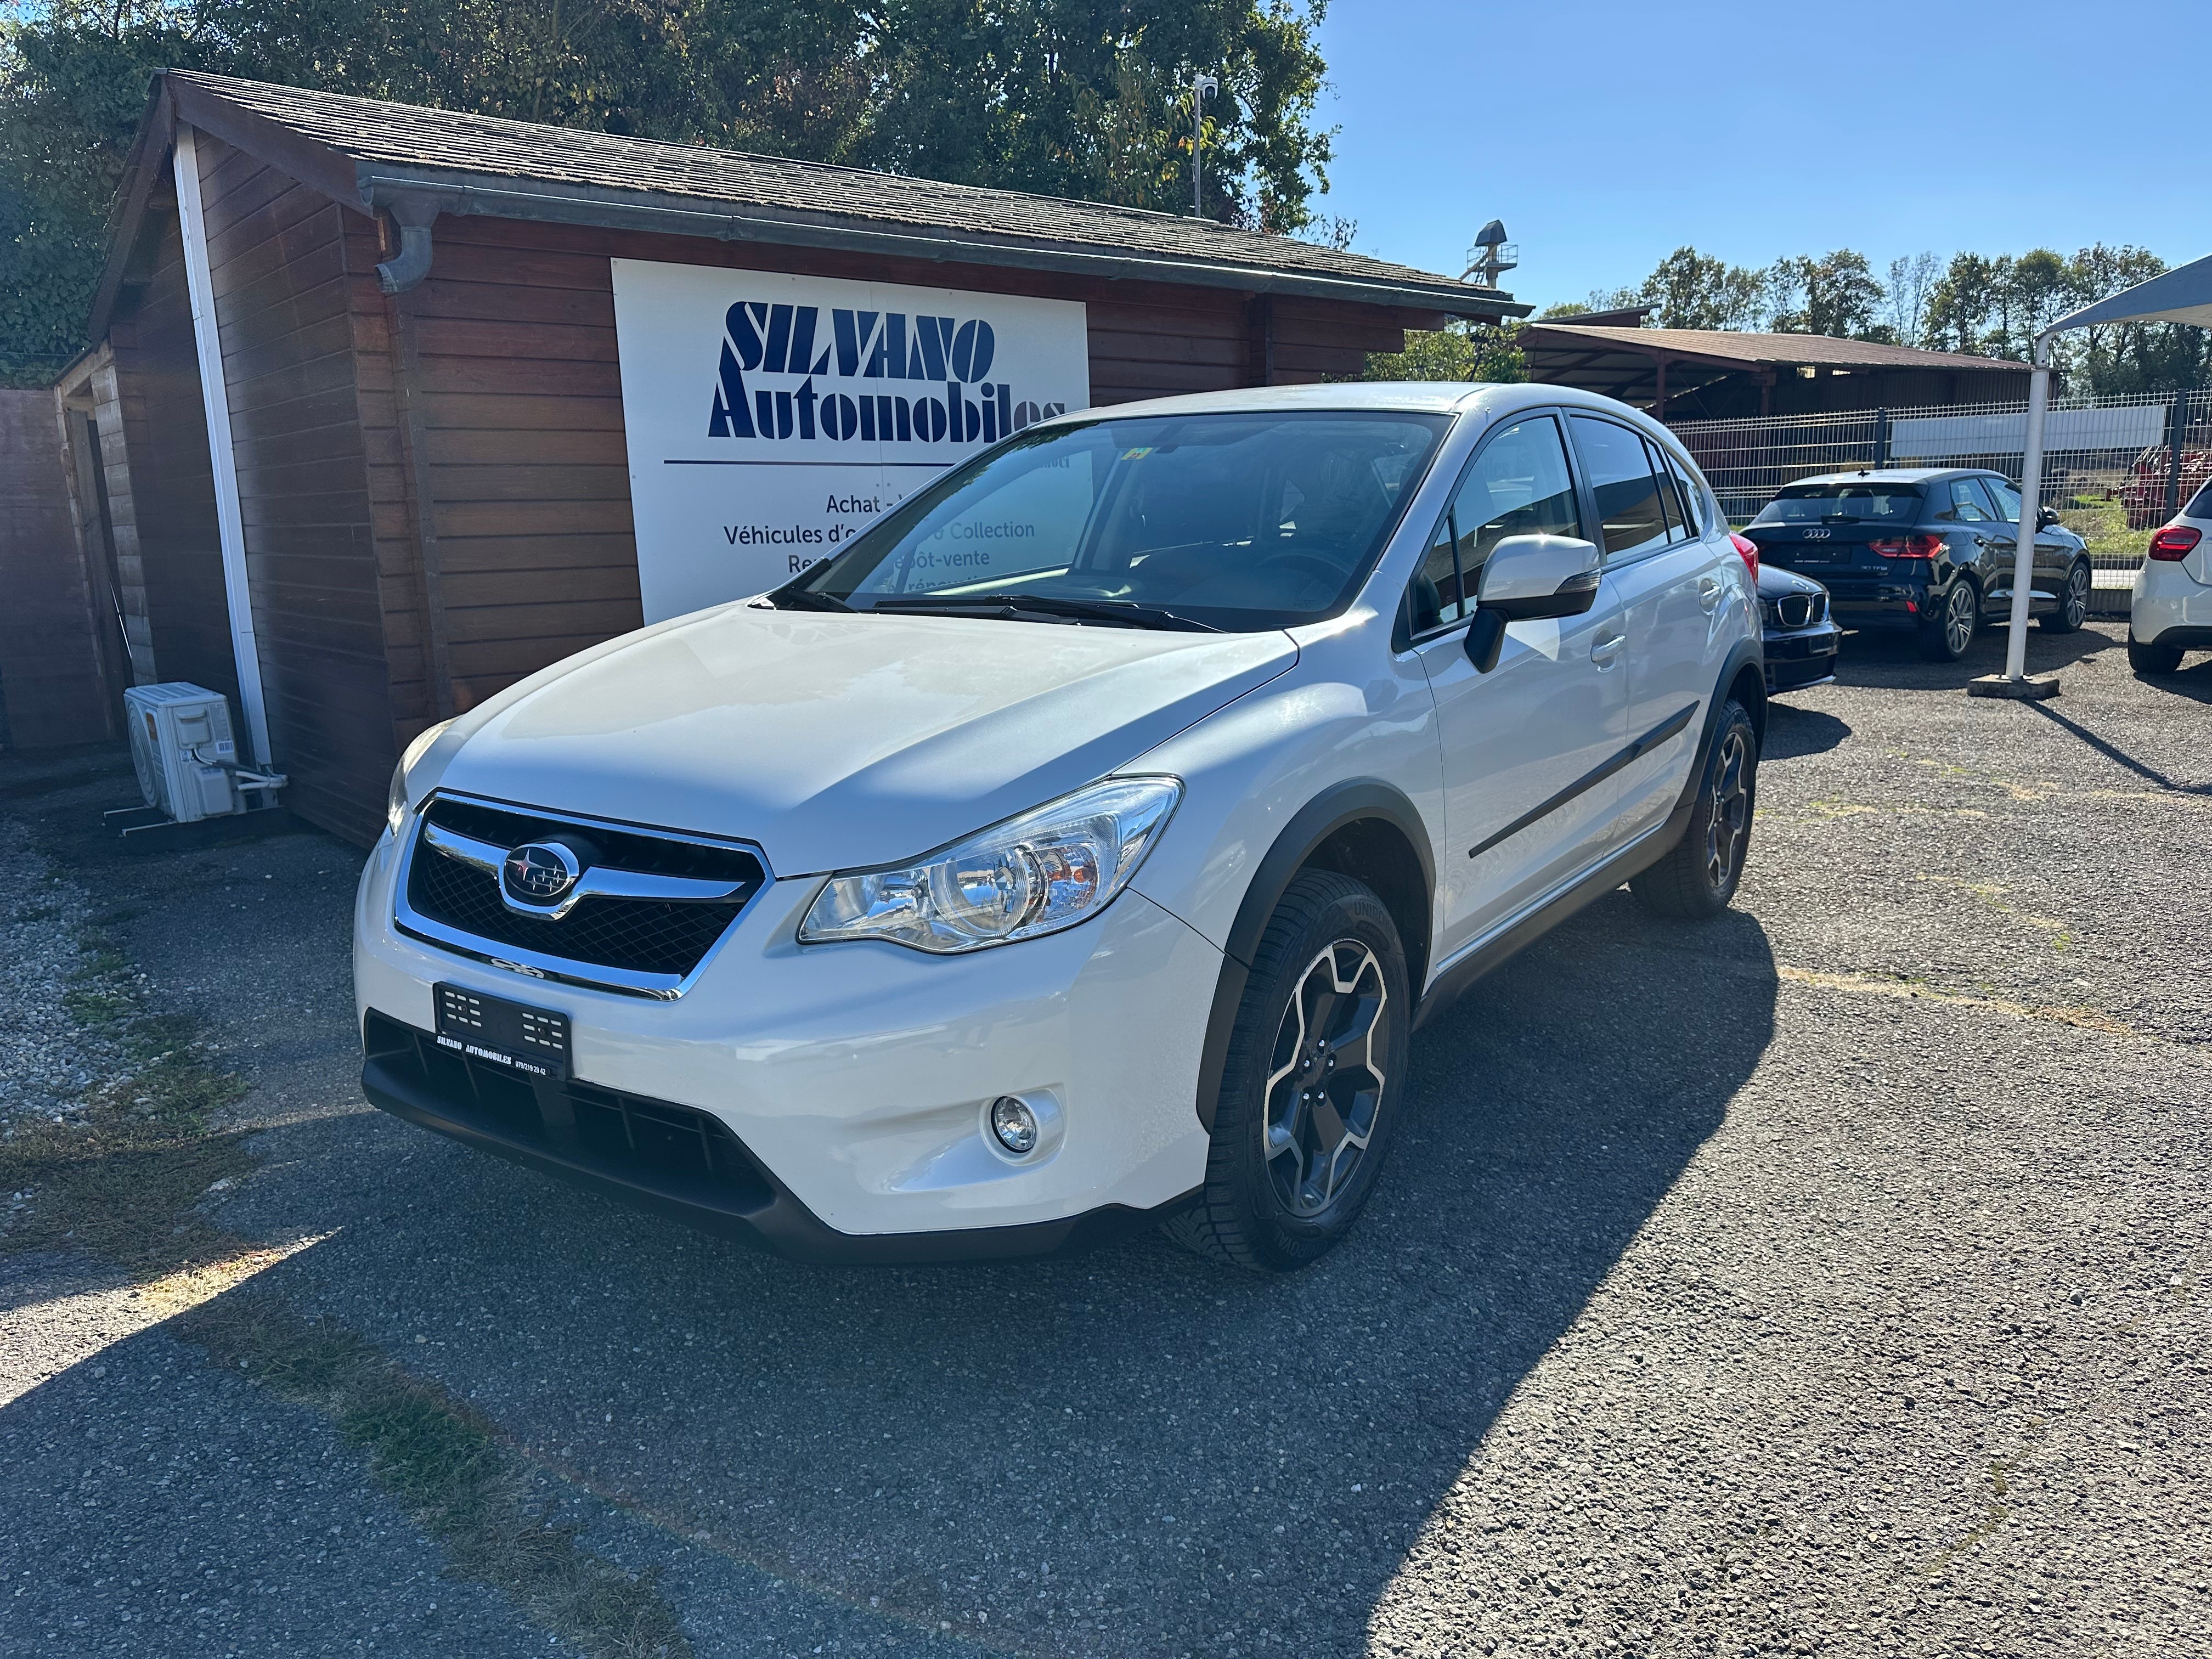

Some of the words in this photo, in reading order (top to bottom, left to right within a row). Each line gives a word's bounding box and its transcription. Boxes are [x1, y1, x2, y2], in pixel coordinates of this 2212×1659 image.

[725, 300, 995, 383] SILVANO
[826, 494, 881, 513] Achat
[723, 525, 822, 545] Véhicules
[950, 521, 1035, 539] Collection
[437, 1035, 462, 1050] SILVANO
[465, 1044, 512, 1065] AUTOMOBILES
